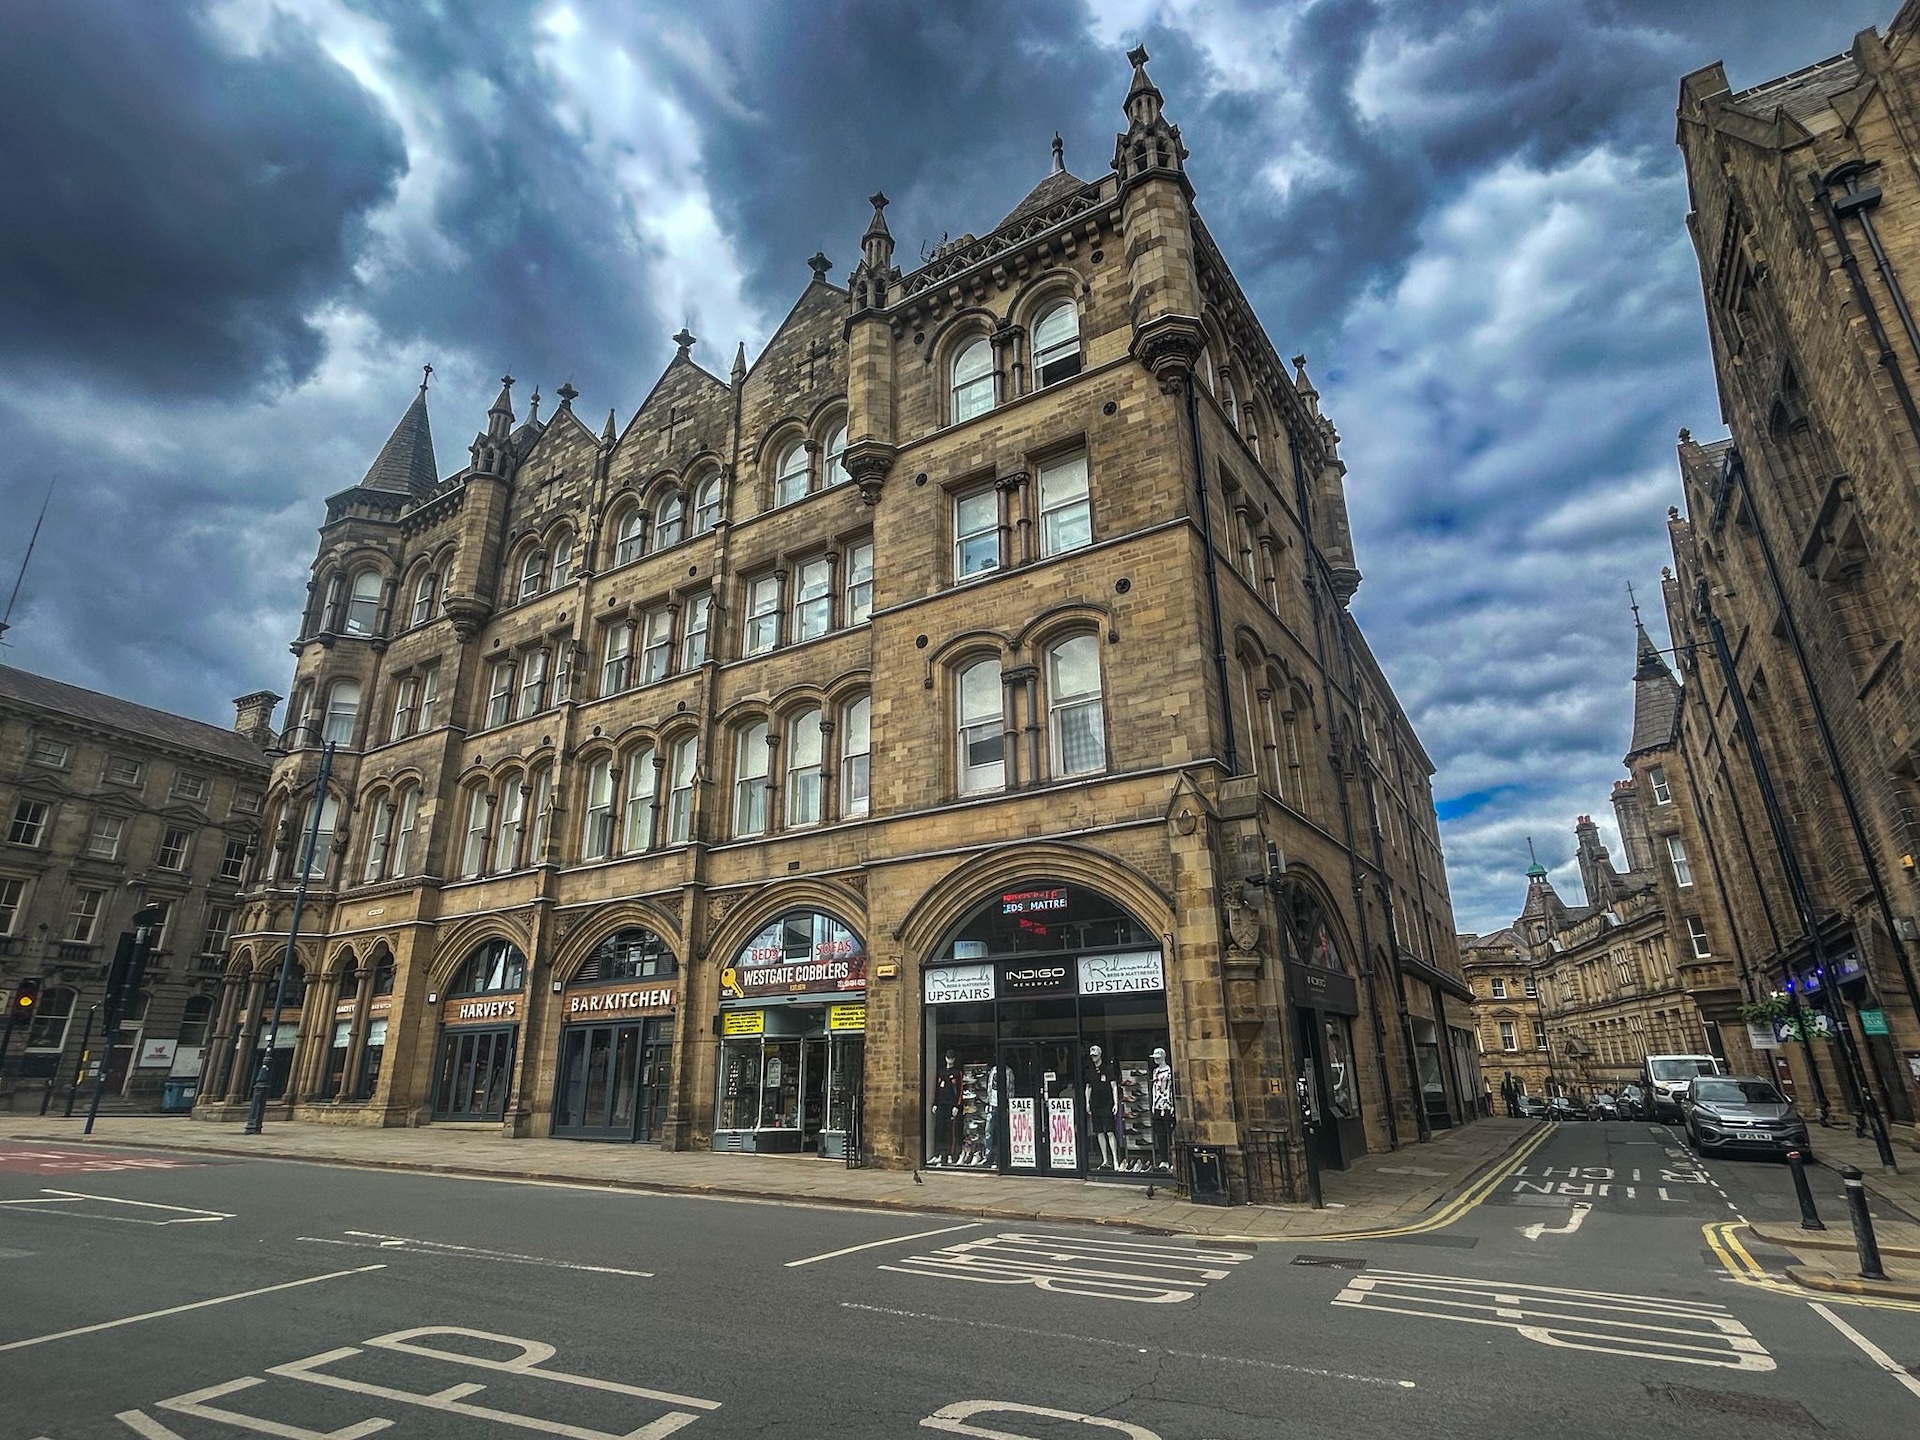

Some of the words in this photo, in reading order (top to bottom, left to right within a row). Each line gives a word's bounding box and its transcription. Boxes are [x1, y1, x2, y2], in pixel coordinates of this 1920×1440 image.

[815, 940, 852, 956] SOFAS
[743, 969, 793, 987] WESTGATE
[795, 962, 849, 983] COBBLERS
[1006, 967, 1065, 980] INDIGO
[1084, 953, 1160, 979] Redmonds
[927, 965, 990, 989] Redmonds
[1085, 977, 1160, 993] UPSTAIRS
[928, 988, 990, 1002] UPSTAIRS
[459, 1001, 515, 1019] HARVEY'S
[1270, 1080, 1280, 1091] H
[1011, 1100, 1032, 1109] SALE
[1051, 1100, 1072, 1110] SALE
[1013, 1114, 1033, 1142] 50%
[1051, 1114, 1073, 1143] 50%
[1013, 1145, 1033, 1154] OFF
[1053, 1146, 1074, 1156] OFF
[1509, 1166, 1707, 1184] RIGHT
[1512, 1180, 1690, 1203] TURN
[877, 1233, 1253, 1304] CLEAR
[1330, 1268, 1777, 1372] KEEP
